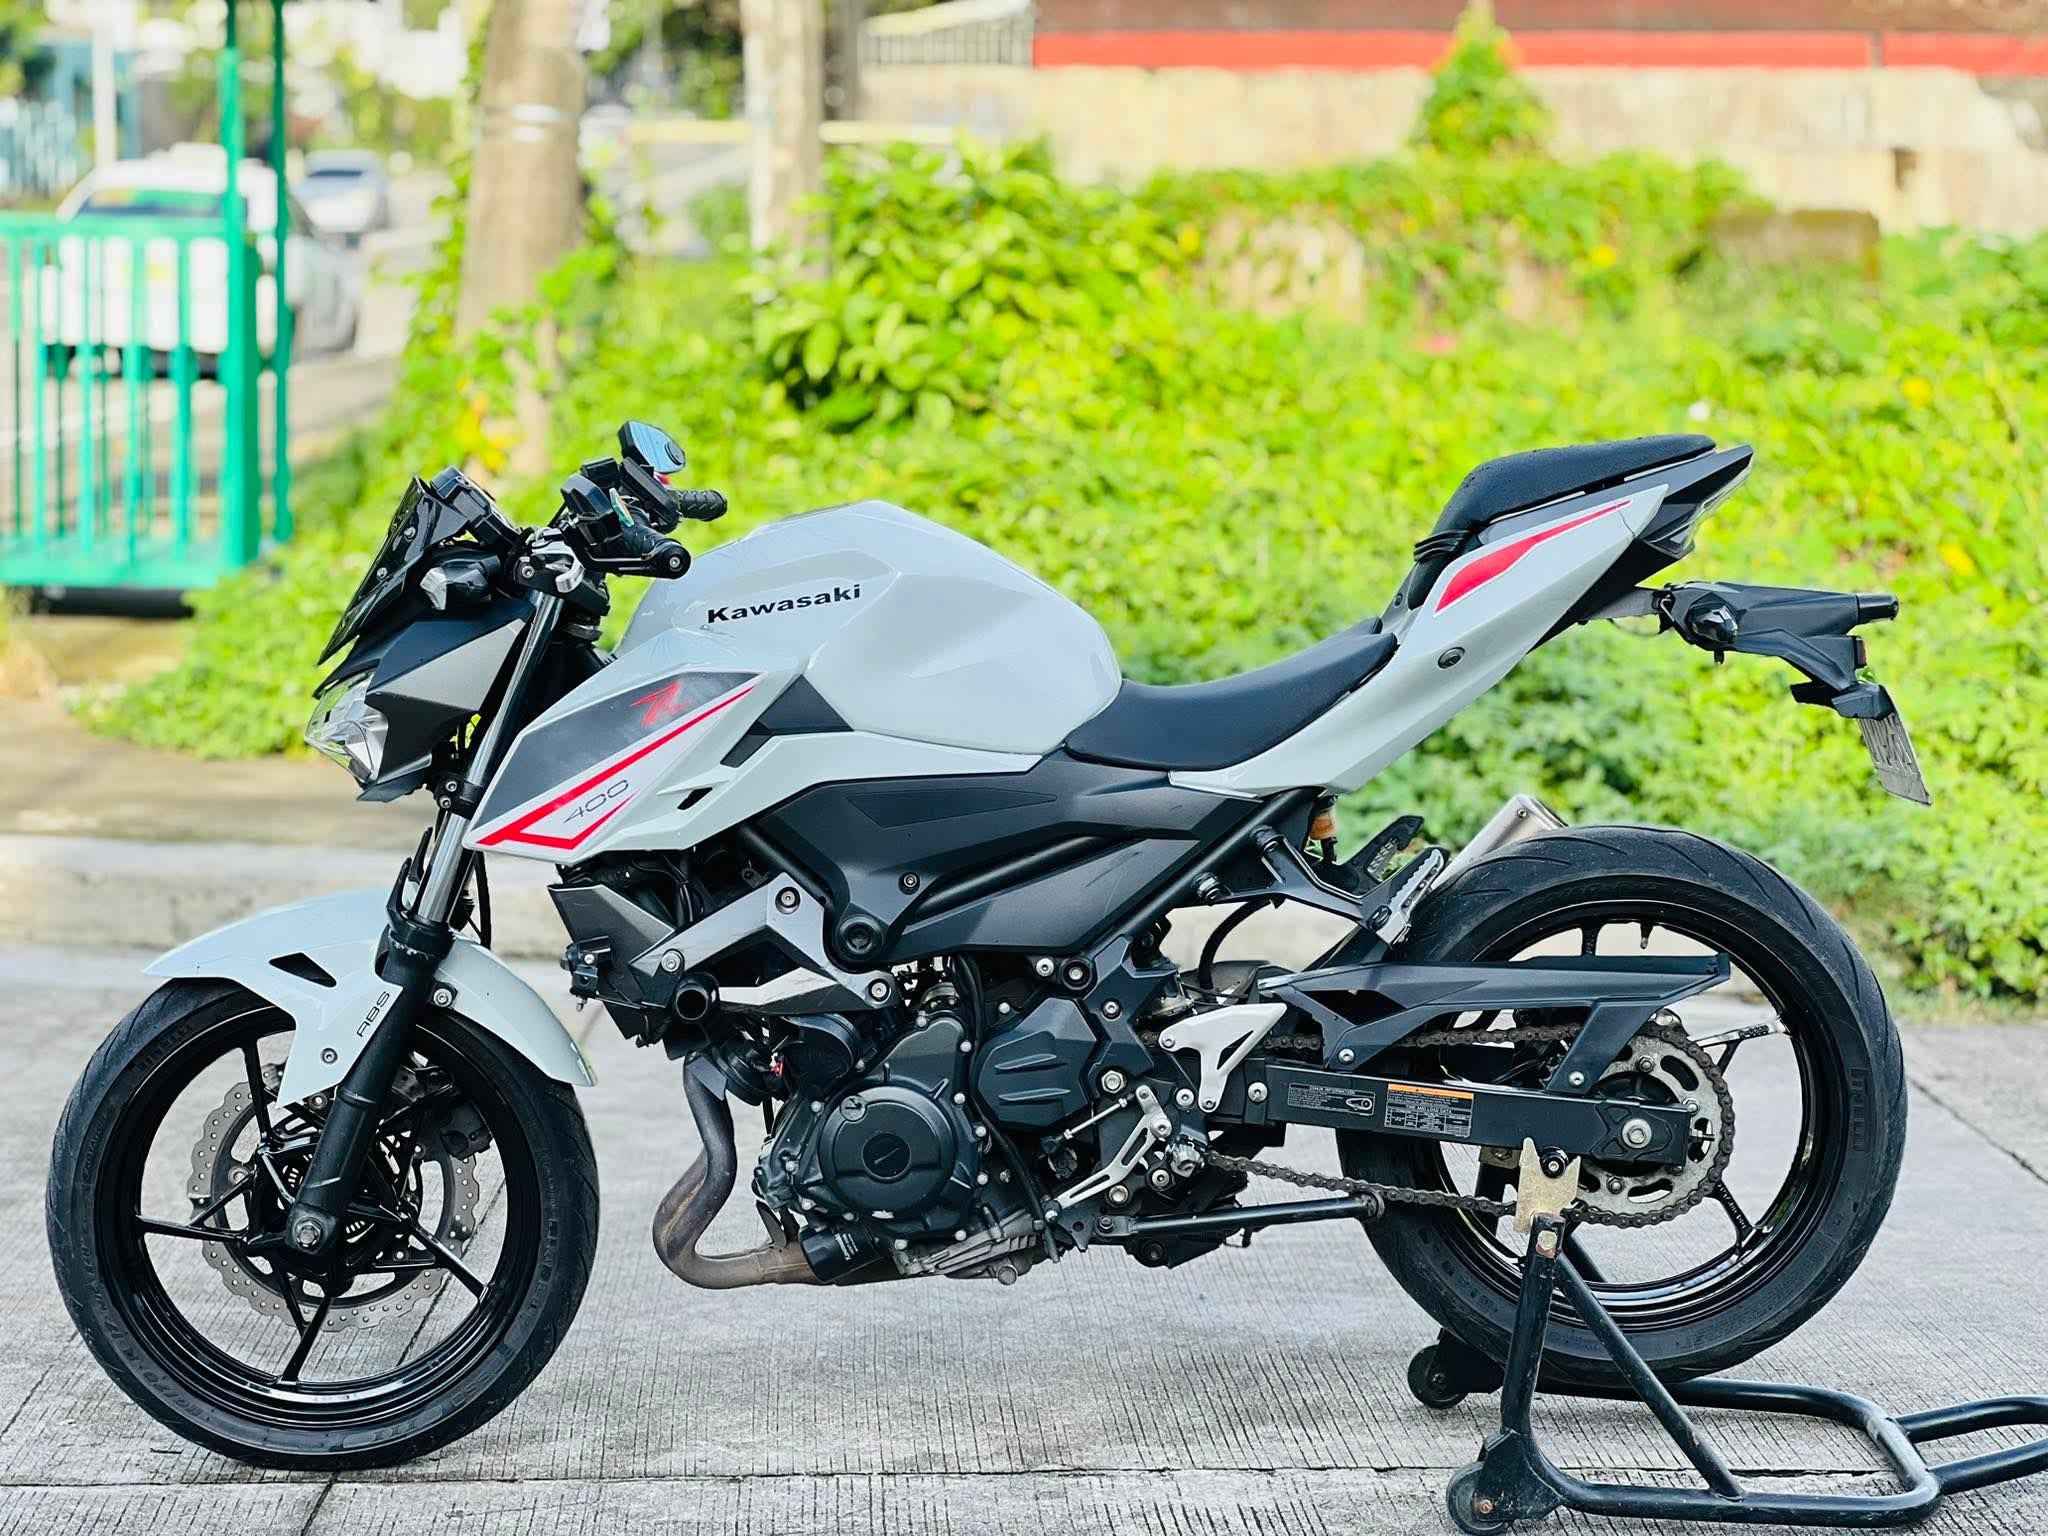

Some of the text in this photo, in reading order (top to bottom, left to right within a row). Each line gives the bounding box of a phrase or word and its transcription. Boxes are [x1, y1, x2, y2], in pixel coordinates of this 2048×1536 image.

[707, 584, 861, 623] Kawasaki
[564, 779, 629, 823] 400
[357, 991, 390, 1037] ABS
